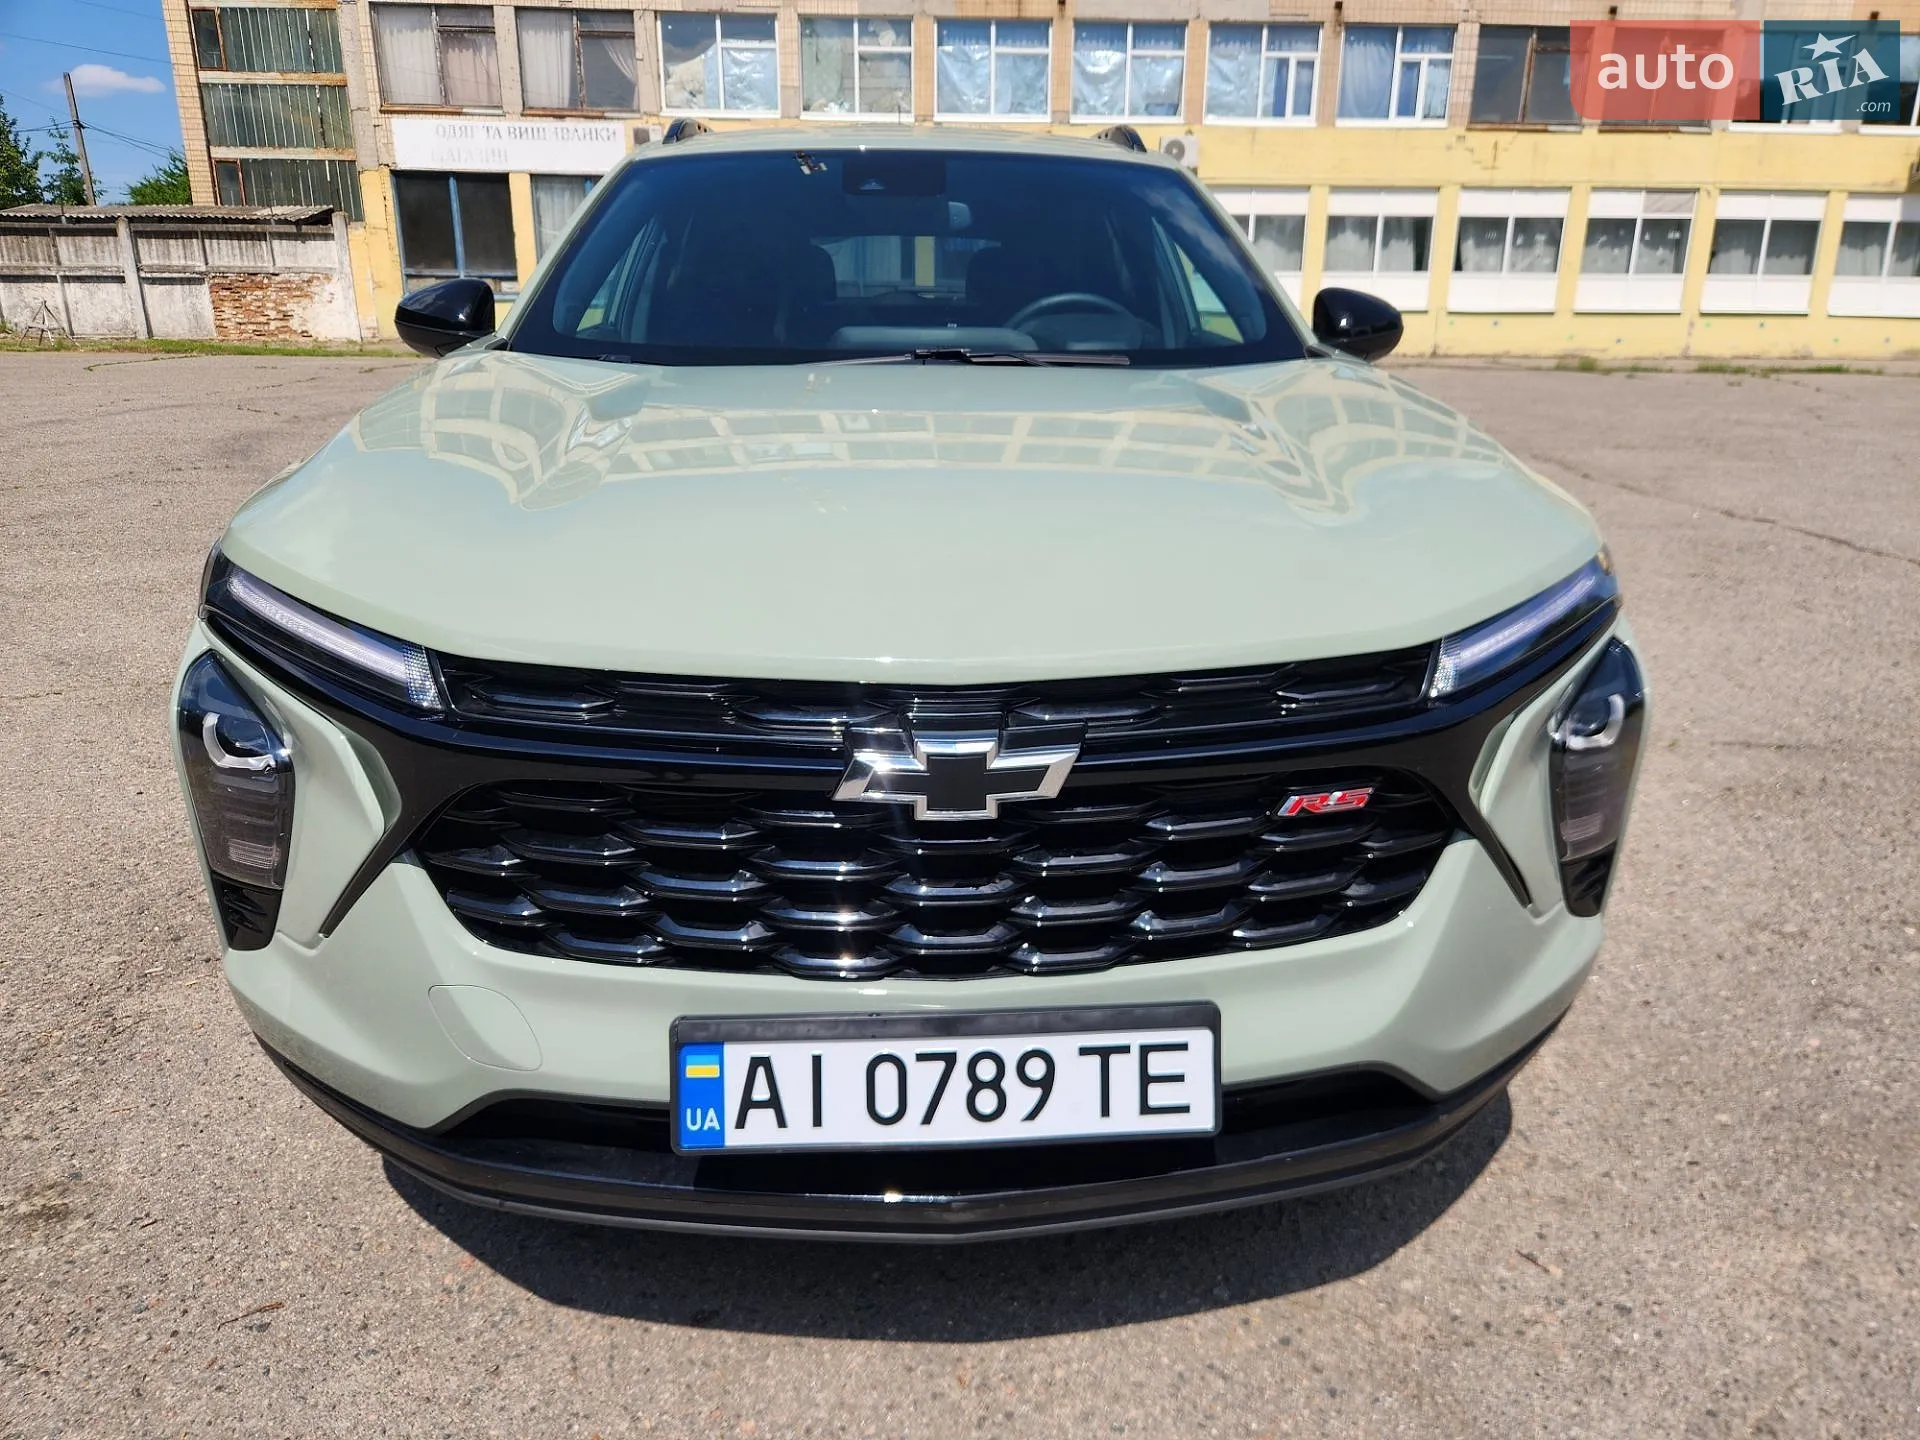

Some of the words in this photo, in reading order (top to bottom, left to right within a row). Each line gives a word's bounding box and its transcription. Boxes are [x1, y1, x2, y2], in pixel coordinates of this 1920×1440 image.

[1277, 787, 1374, 817] RS
[735, 1053, 824, 1129] AI
[865, 1046, 1056, 1126] 0789
[1078, 1041, 1191, 1119] TE
[685, 1107, 720, 1132] UA
